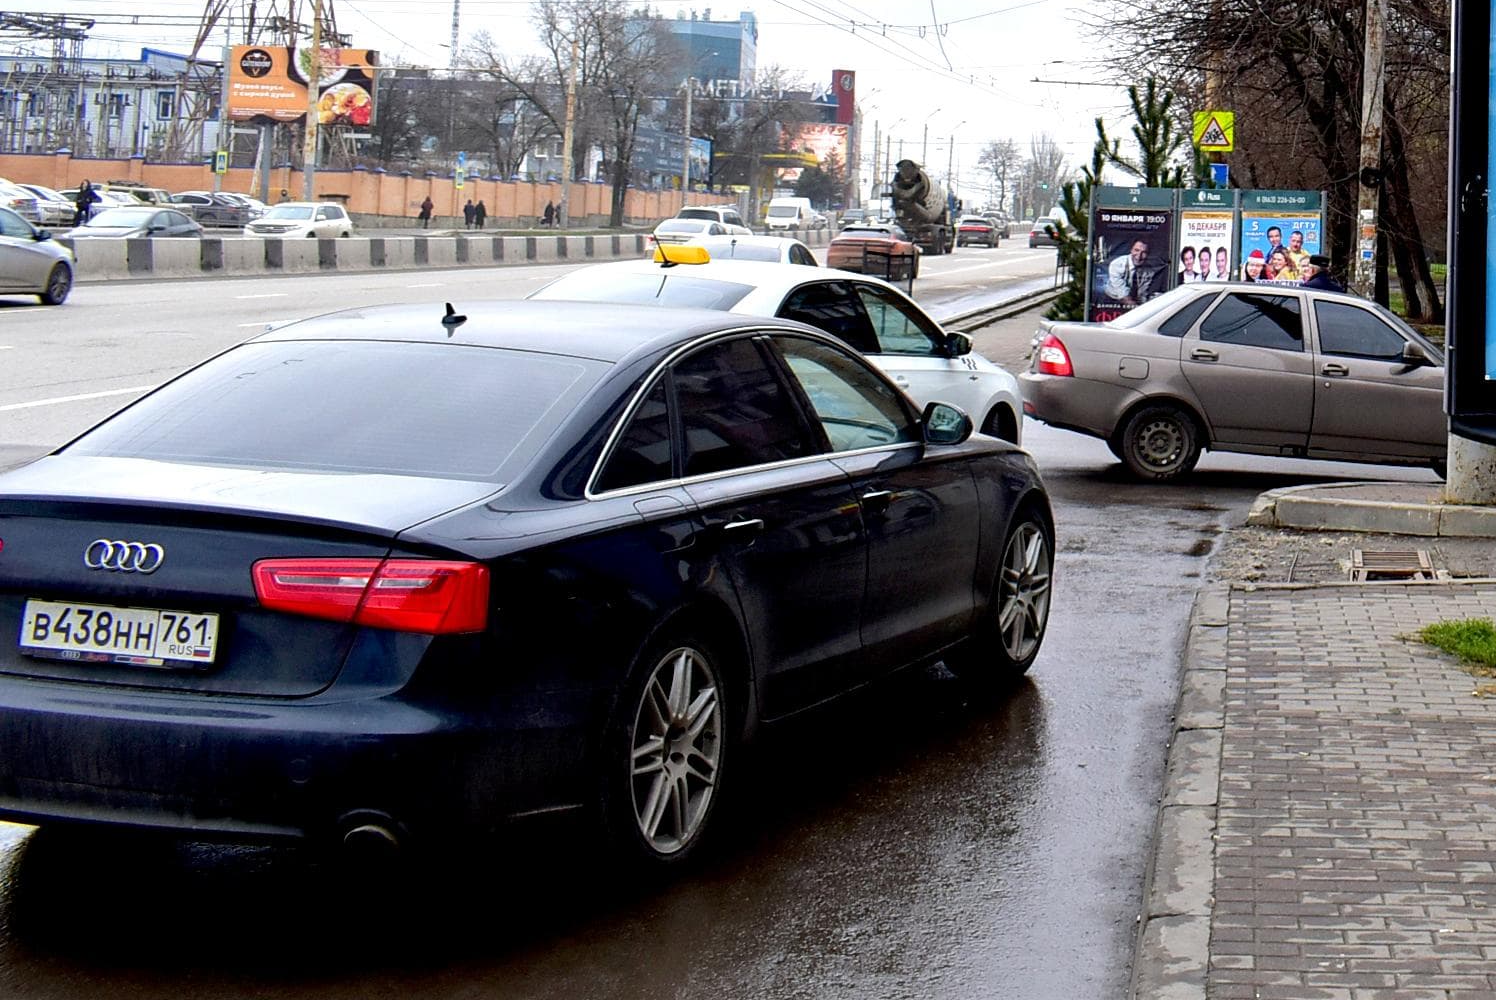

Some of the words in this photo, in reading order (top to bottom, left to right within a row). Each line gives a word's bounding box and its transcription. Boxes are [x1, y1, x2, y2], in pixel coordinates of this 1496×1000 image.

[1101, 214, 1111, 222] 10
[1111, 214, 1145, 223] ЯНВАРЯ
[1146, 215, 1166, 224] 19:00
[1196, 223, 1227, 231] ДЕКАБРЯ
[1251, 221, 1259, 231] 5
[33, 607, 154, 651] В438НН
[162, 614, 210, 646] 761
[169, 645, 194, 656] RUS
